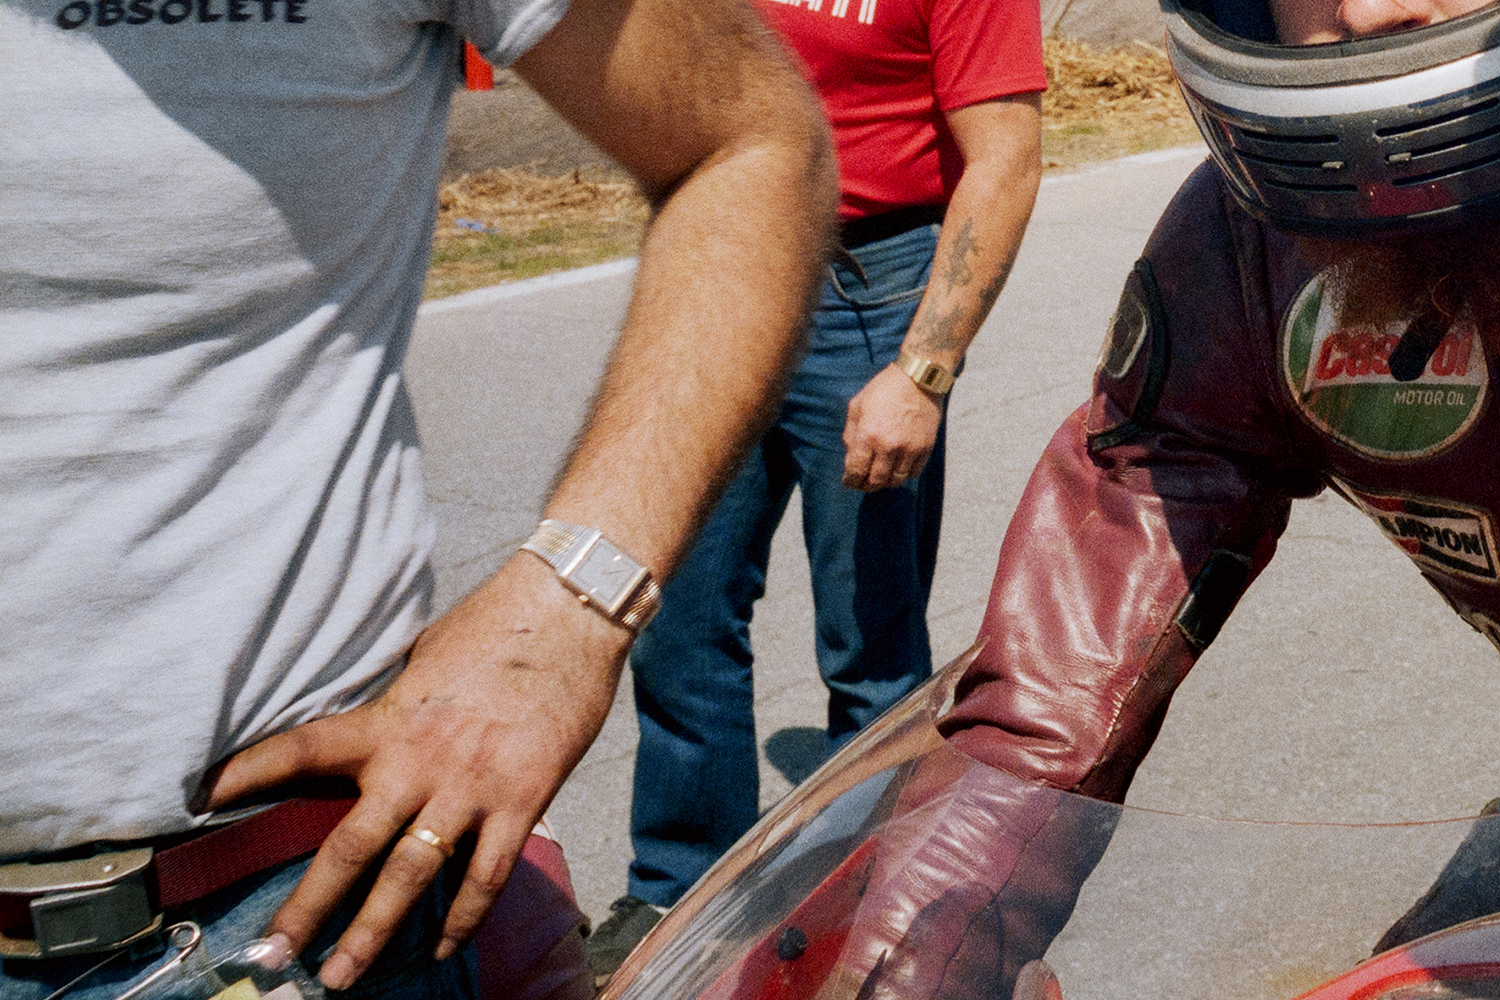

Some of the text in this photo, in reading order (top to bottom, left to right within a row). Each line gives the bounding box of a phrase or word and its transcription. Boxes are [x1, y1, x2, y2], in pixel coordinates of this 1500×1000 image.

[1315, 331, 1474, 381] Casol
[1393, 388, 1467, 406] MOTOR OIL
